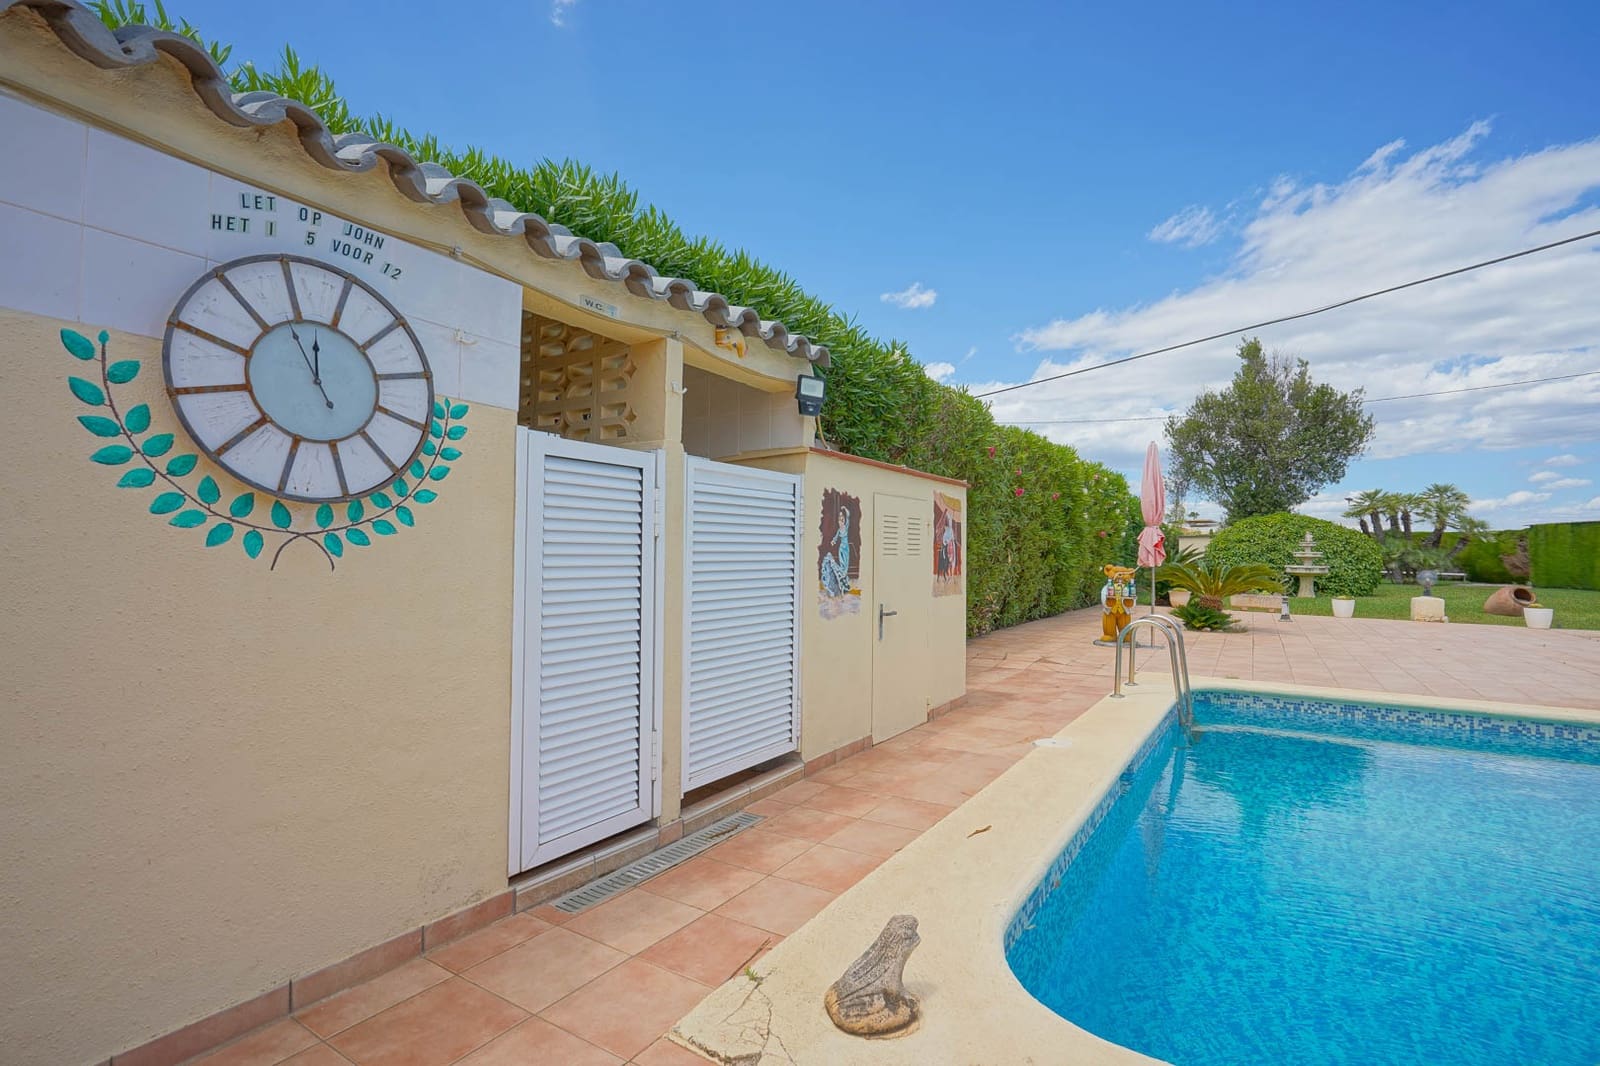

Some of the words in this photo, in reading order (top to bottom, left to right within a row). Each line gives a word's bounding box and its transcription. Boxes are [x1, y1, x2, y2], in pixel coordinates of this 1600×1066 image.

[212, 214, 250, 233] HET
[306, 231, 316, 246] 5
[333, 239, 374, 265] VOOR
[383, 263, 402, 280] 12
[241, 193, 275, 211] LET
[299, 207, 322, 225] OP
[344, 224, 385, 250] JOHN
